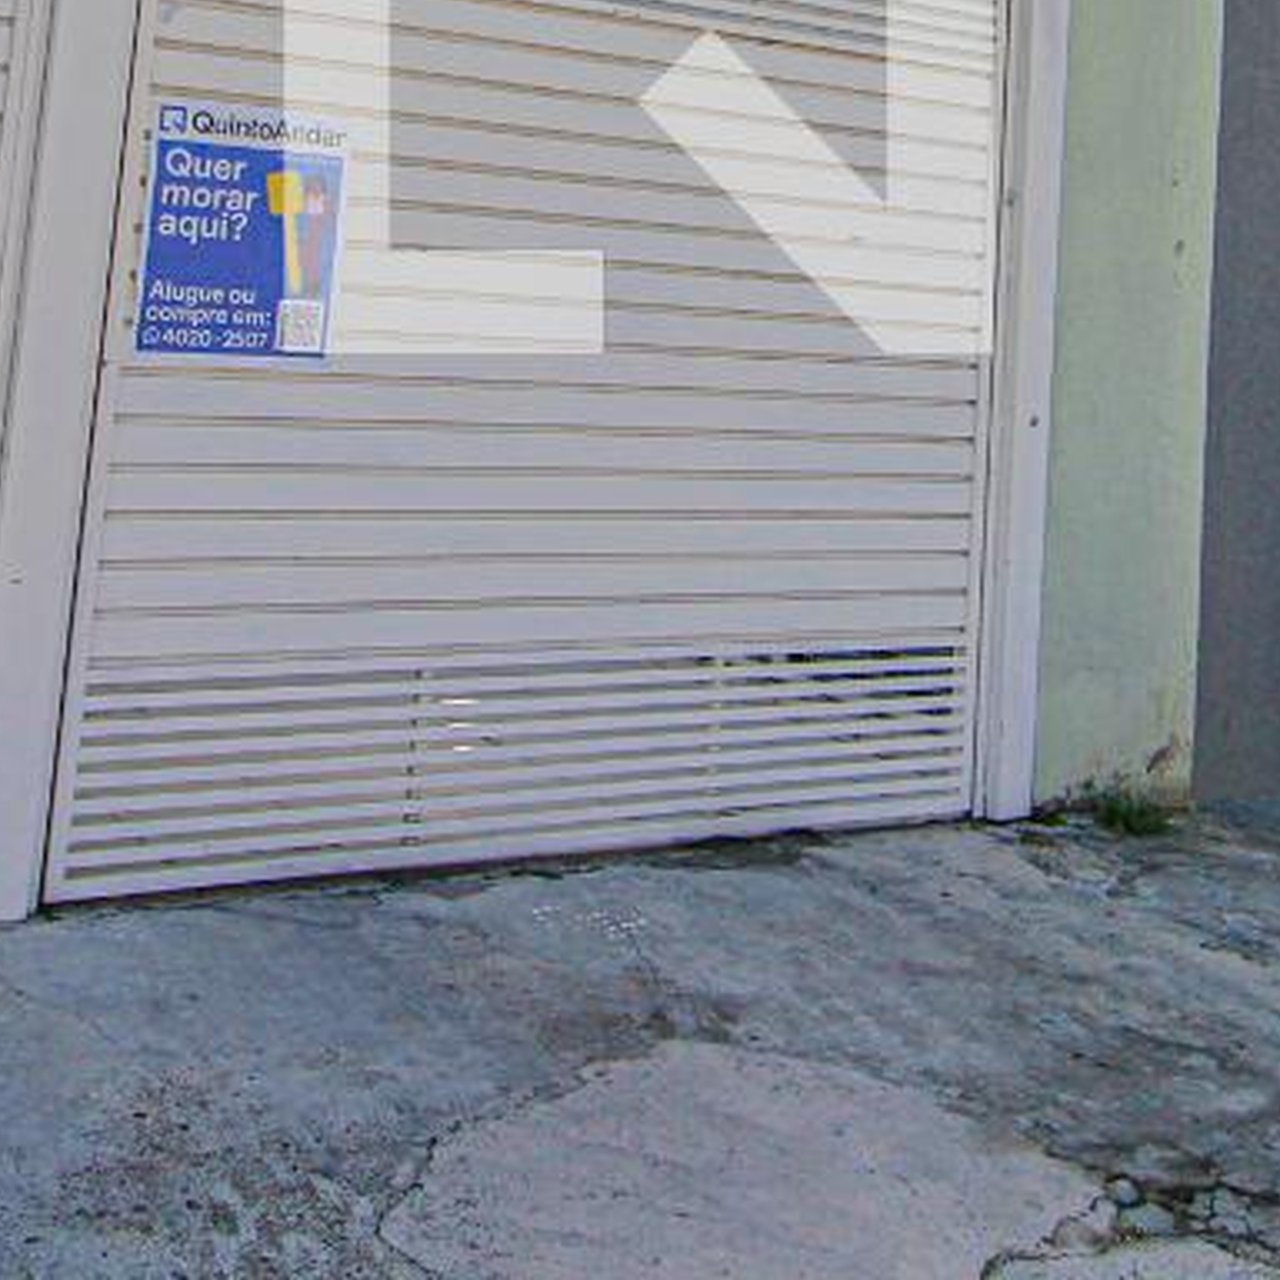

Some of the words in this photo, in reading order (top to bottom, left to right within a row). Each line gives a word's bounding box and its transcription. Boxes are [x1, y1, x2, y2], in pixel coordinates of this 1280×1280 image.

[165, 149, 247, 181] Quer
[161, 184, 258, 212] morar
[158, 213, 248, 244] aqui?
[149, 279, 224, 306] Alugue
[228, 288, 256, 305] ou
[145, 305, 228, 327] compre
[232, 310, 272, 327] em:
